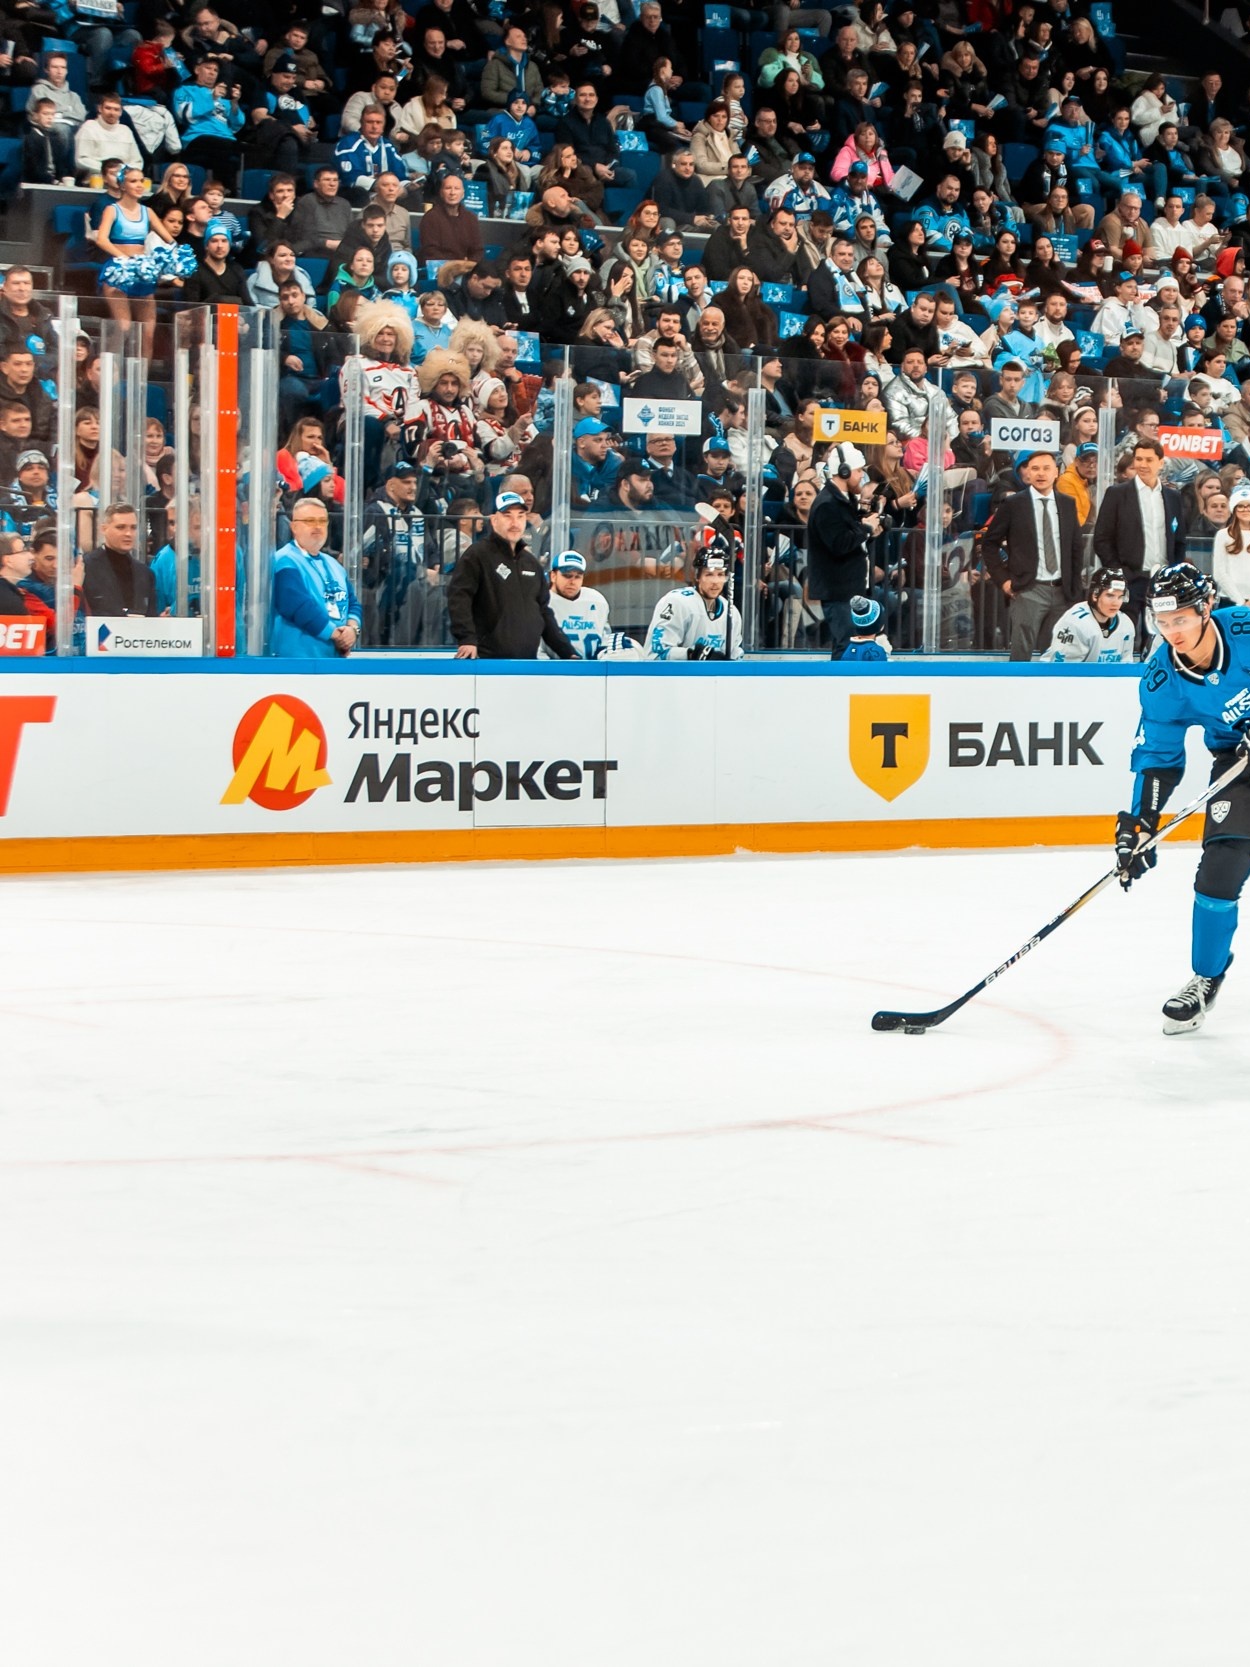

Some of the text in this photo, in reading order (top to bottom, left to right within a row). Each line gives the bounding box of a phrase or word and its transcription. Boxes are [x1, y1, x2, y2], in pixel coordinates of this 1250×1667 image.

[843, 421, 879, 433] БАНК
[1160, 433, 1222, 454] FONBET
[115, 636, 192, 649] Ростелеком
[347, 701, 480, 745] Яндекс
[948, 721, 1105, 767] БАНК
[343, 752, 618, 812] Маркет
